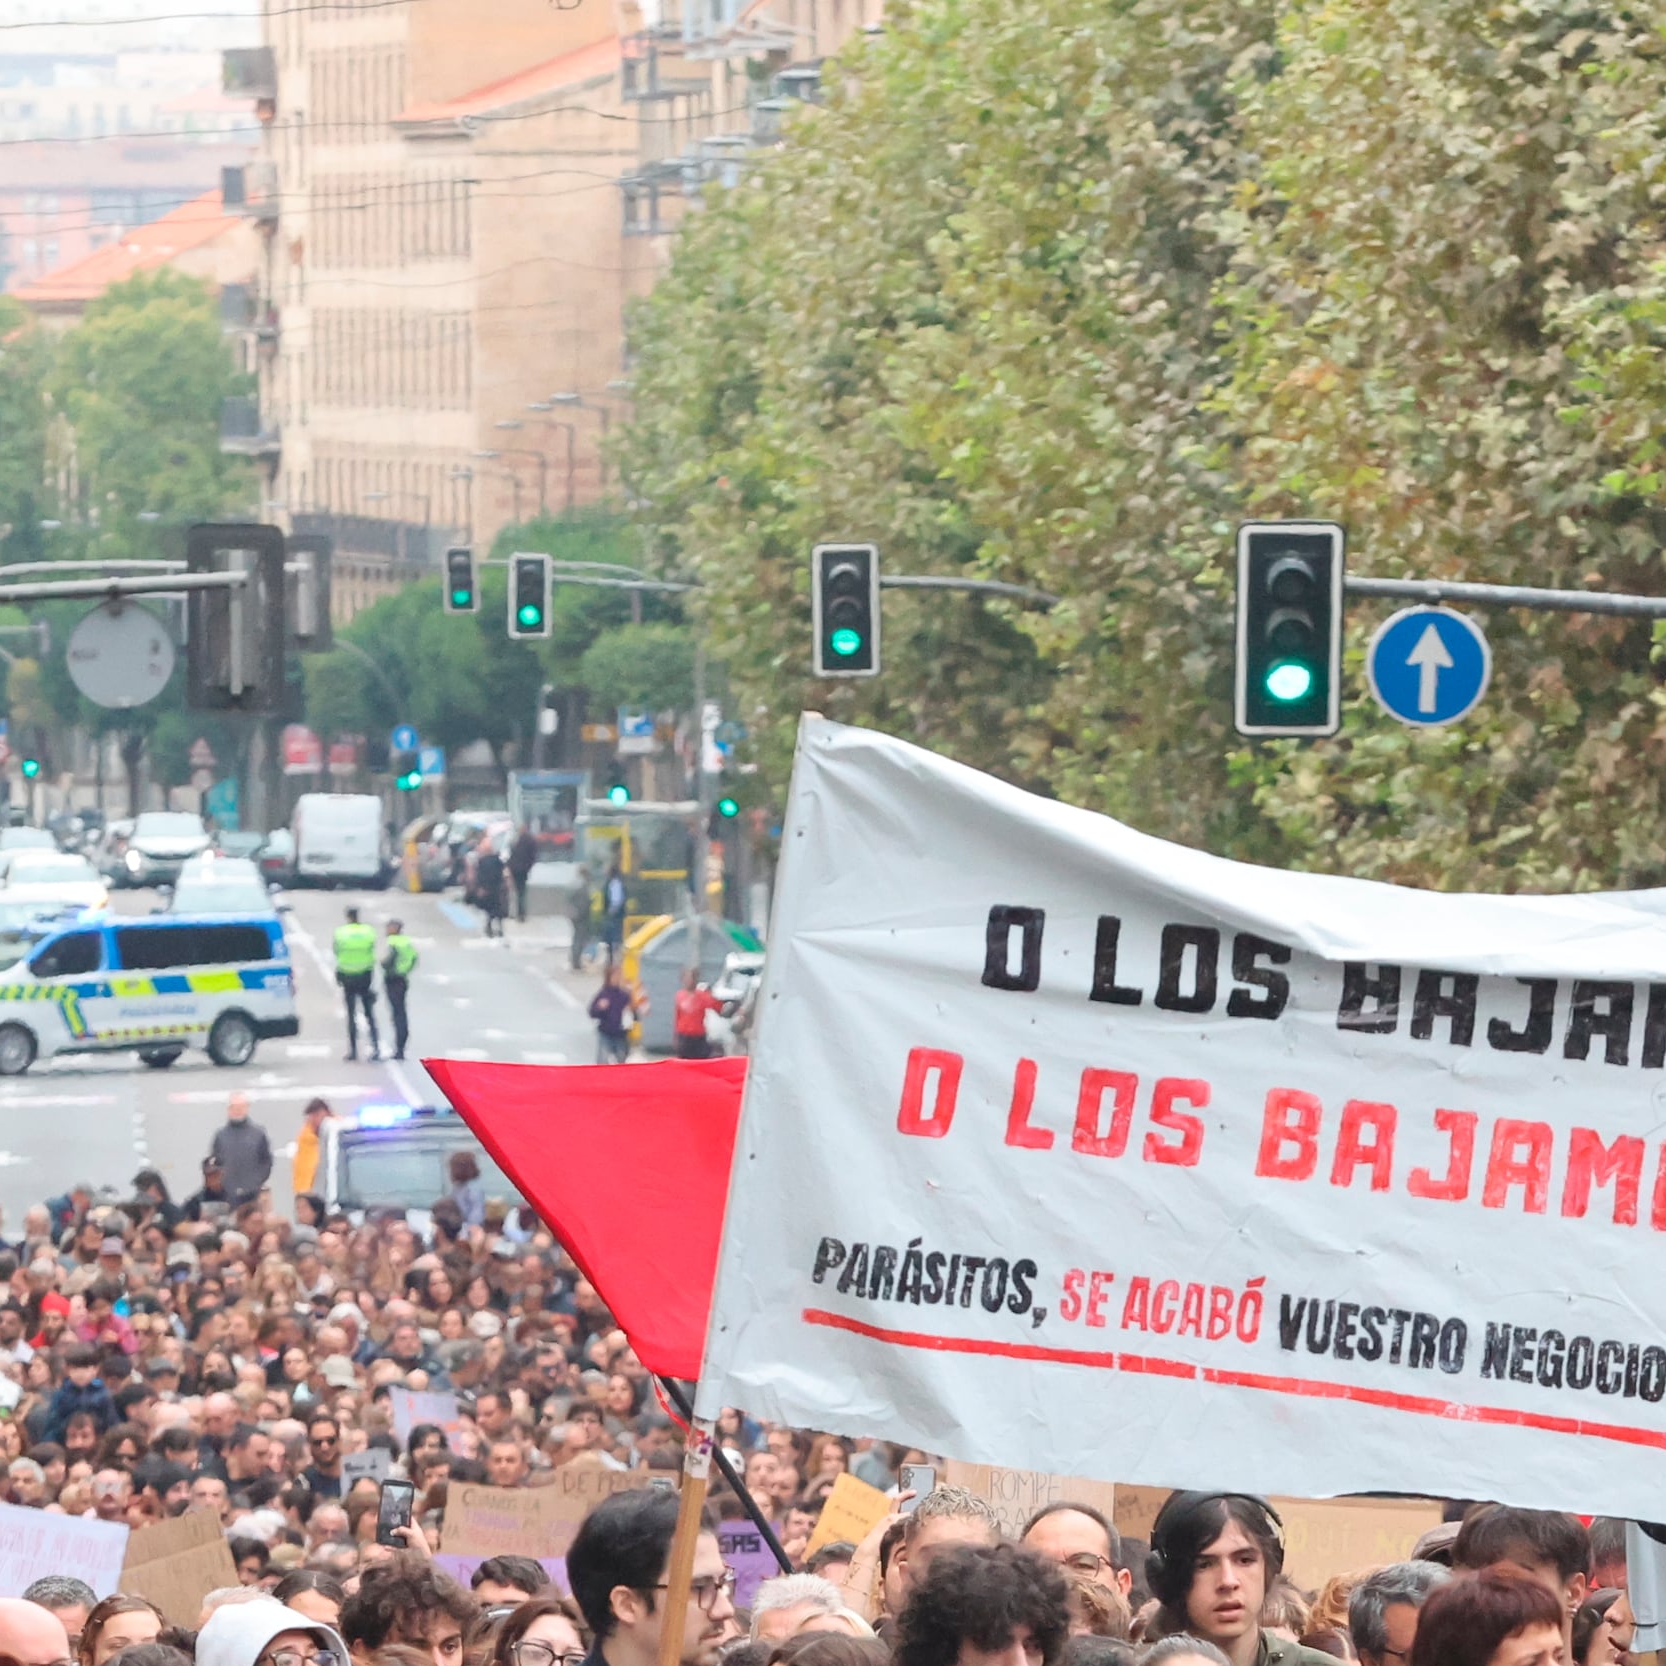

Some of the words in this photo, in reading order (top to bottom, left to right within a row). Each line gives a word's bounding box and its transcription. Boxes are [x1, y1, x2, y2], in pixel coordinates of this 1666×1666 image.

[981, 904, 1045, 991] O
[1090, 915, 1292, 1019] LOS
[897, 1046, 964, 1138] O
[1005, 1057, 1211, 1167] LOS
[811, 1237, 1047, 1329] PARÁSITOS,
[1060, 1268, 1115, 1327] SE
[1121, 1275, 1267, 1343] ACABÓ
[1279, 1294, 1467, 1374] VUESTRO
[990, 1469, 1060, 1504] ROMPE
